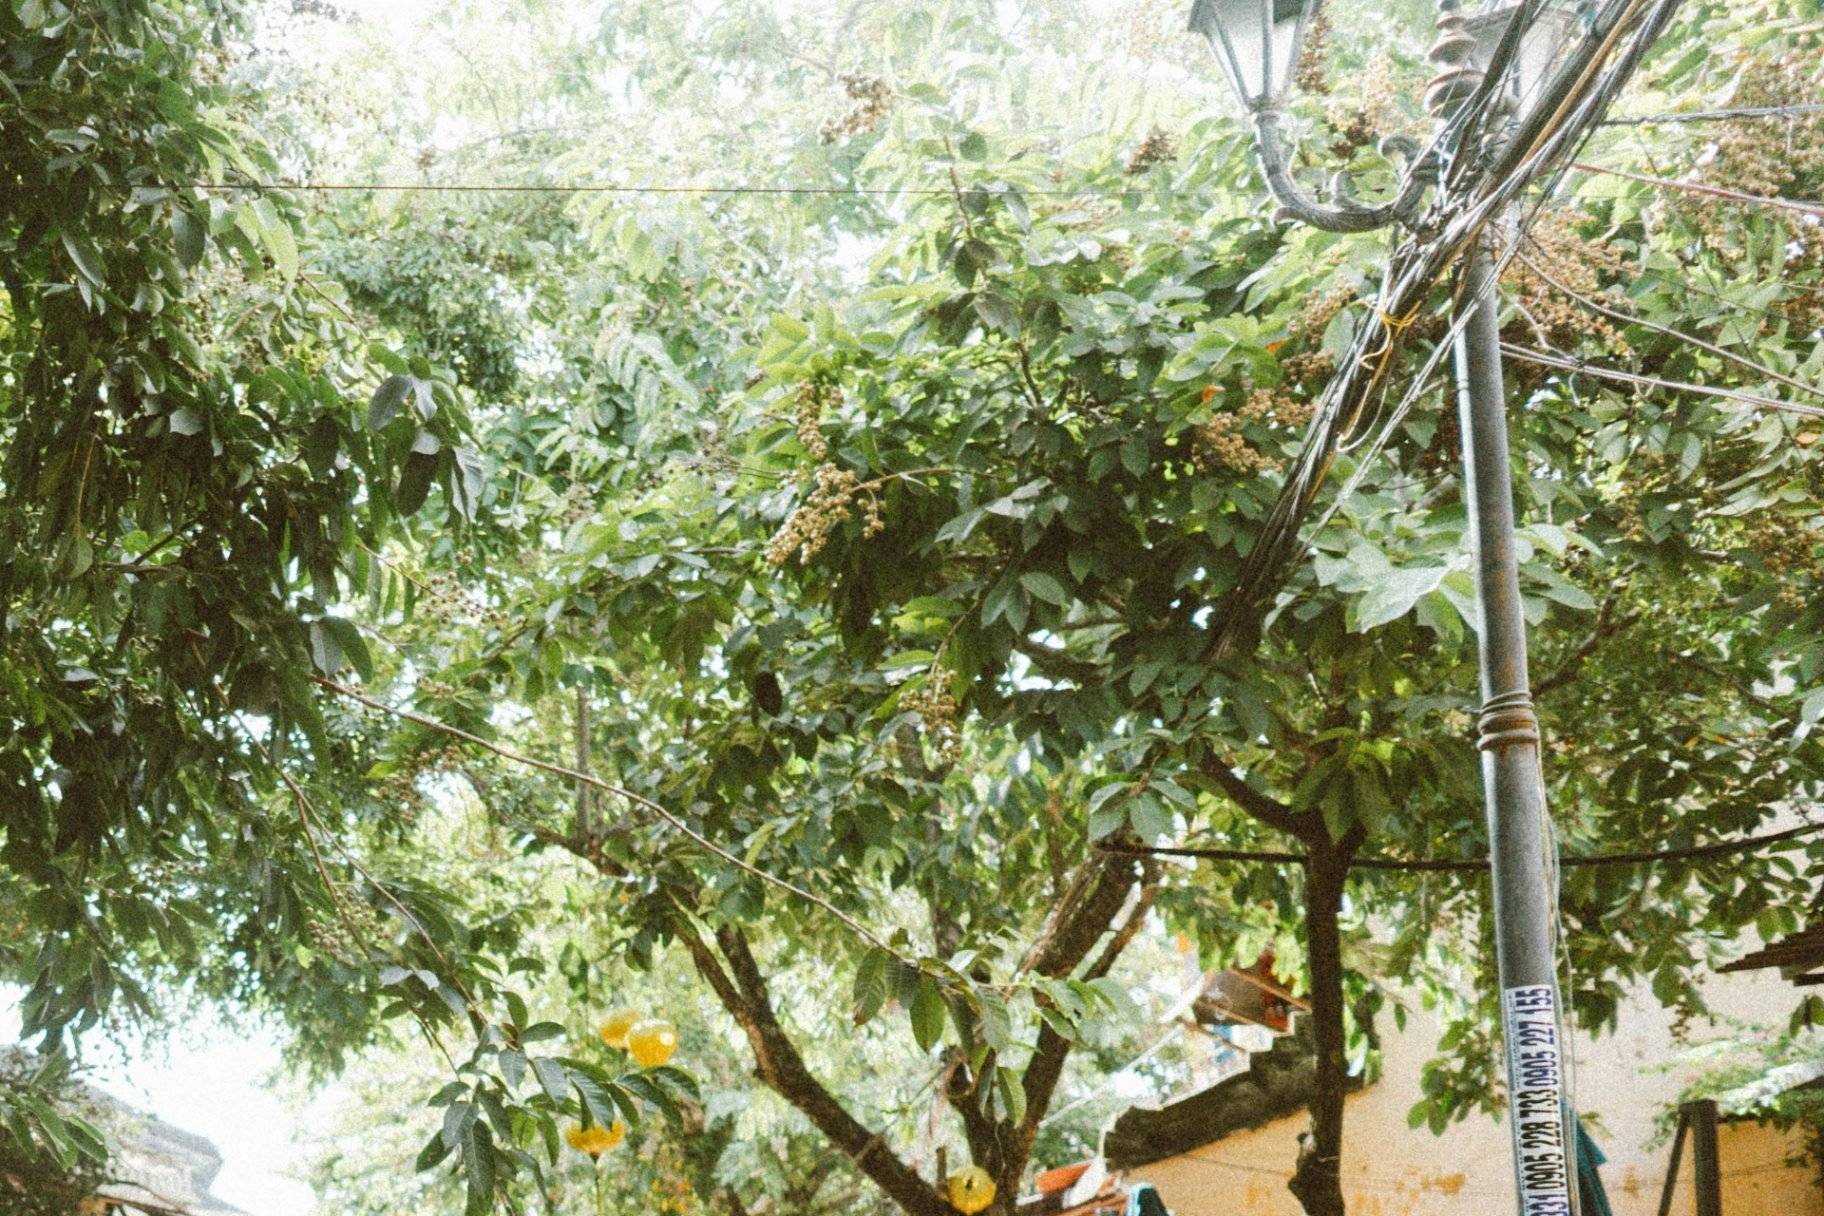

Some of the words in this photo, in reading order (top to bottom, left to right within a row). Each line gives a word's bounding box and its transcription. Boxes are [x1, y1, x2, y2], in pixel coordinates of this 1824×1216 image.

[1515, 988, 1552, 1015] 155
[1518, 1021, 1555, 1045] 227
[1521, 1051, 1558, 1087] 0905
[1517, 1089, 1558, 1119] 733
[1520, 1121, 1561, 1149] 228
[1524, 1153, 1565, 1190] 0905
